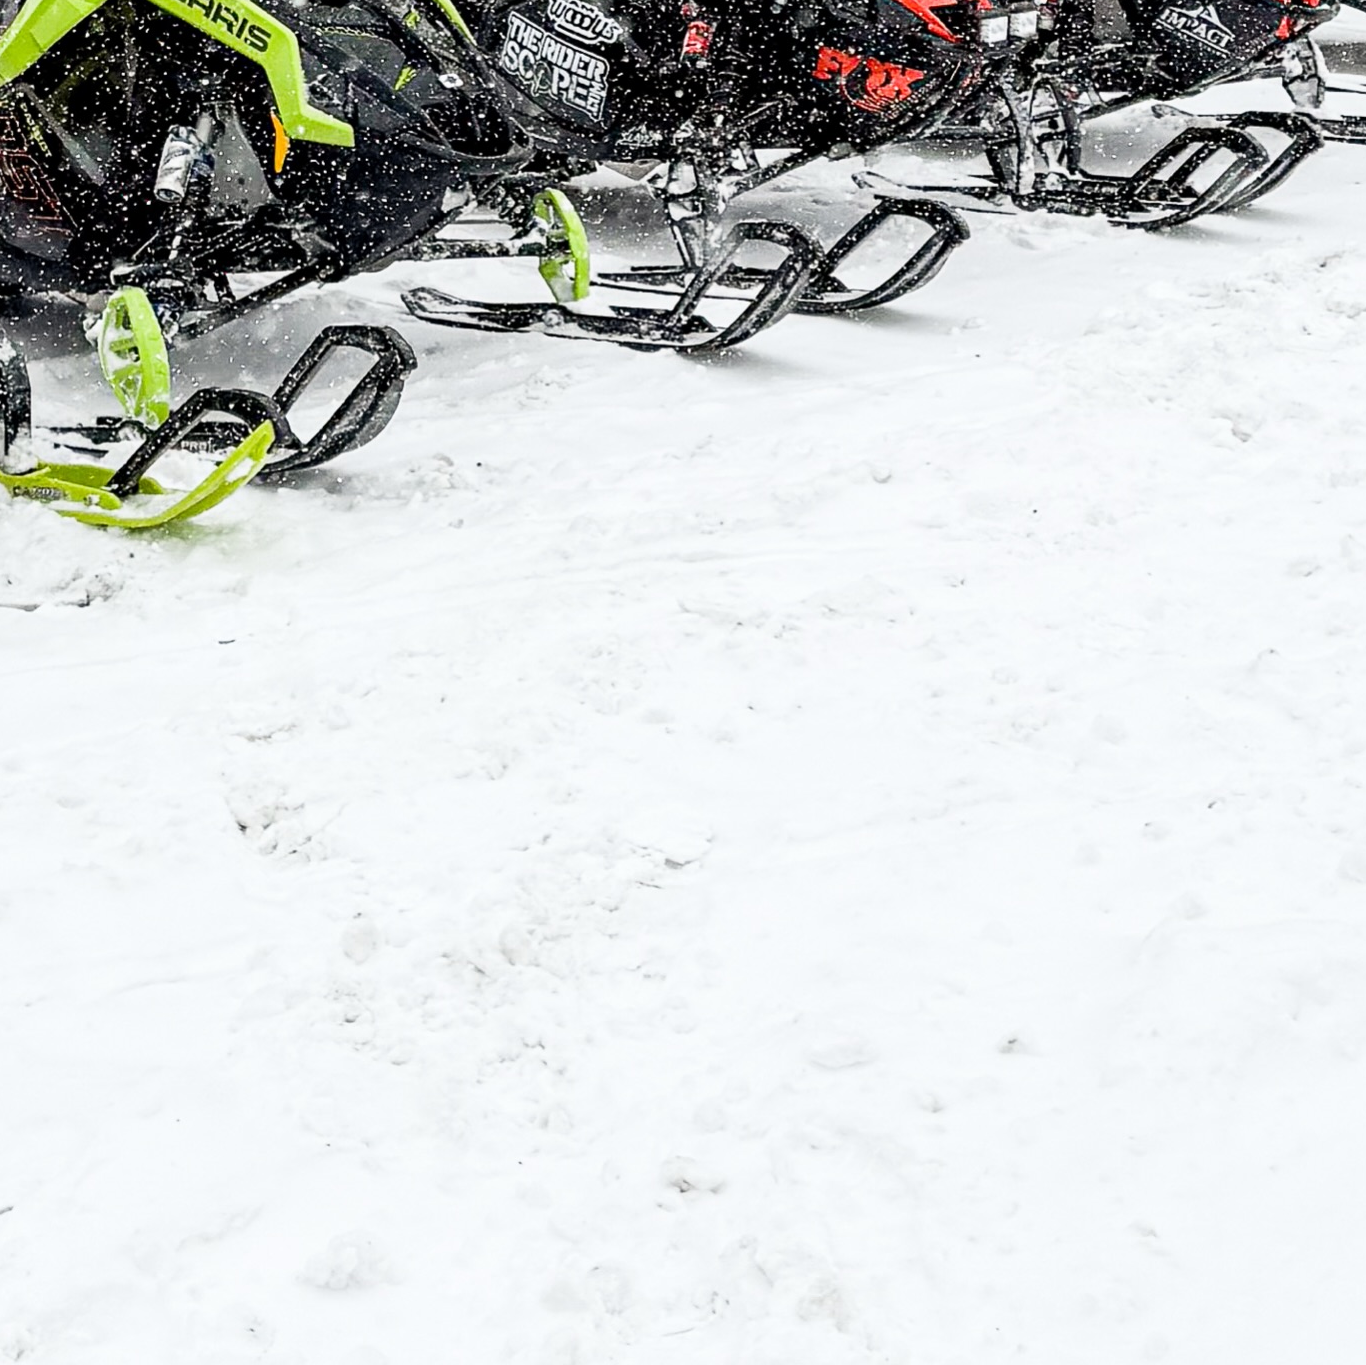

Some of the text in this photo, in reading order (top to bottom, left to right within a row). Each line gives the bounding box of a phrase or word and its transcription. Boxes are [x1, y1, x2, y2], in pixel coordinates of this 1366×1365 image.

[509, 16, 606, 83] THE RIDER
[1159, 7, 1237, 49] IMPACT
[811, 45, 925, 102] FOX
